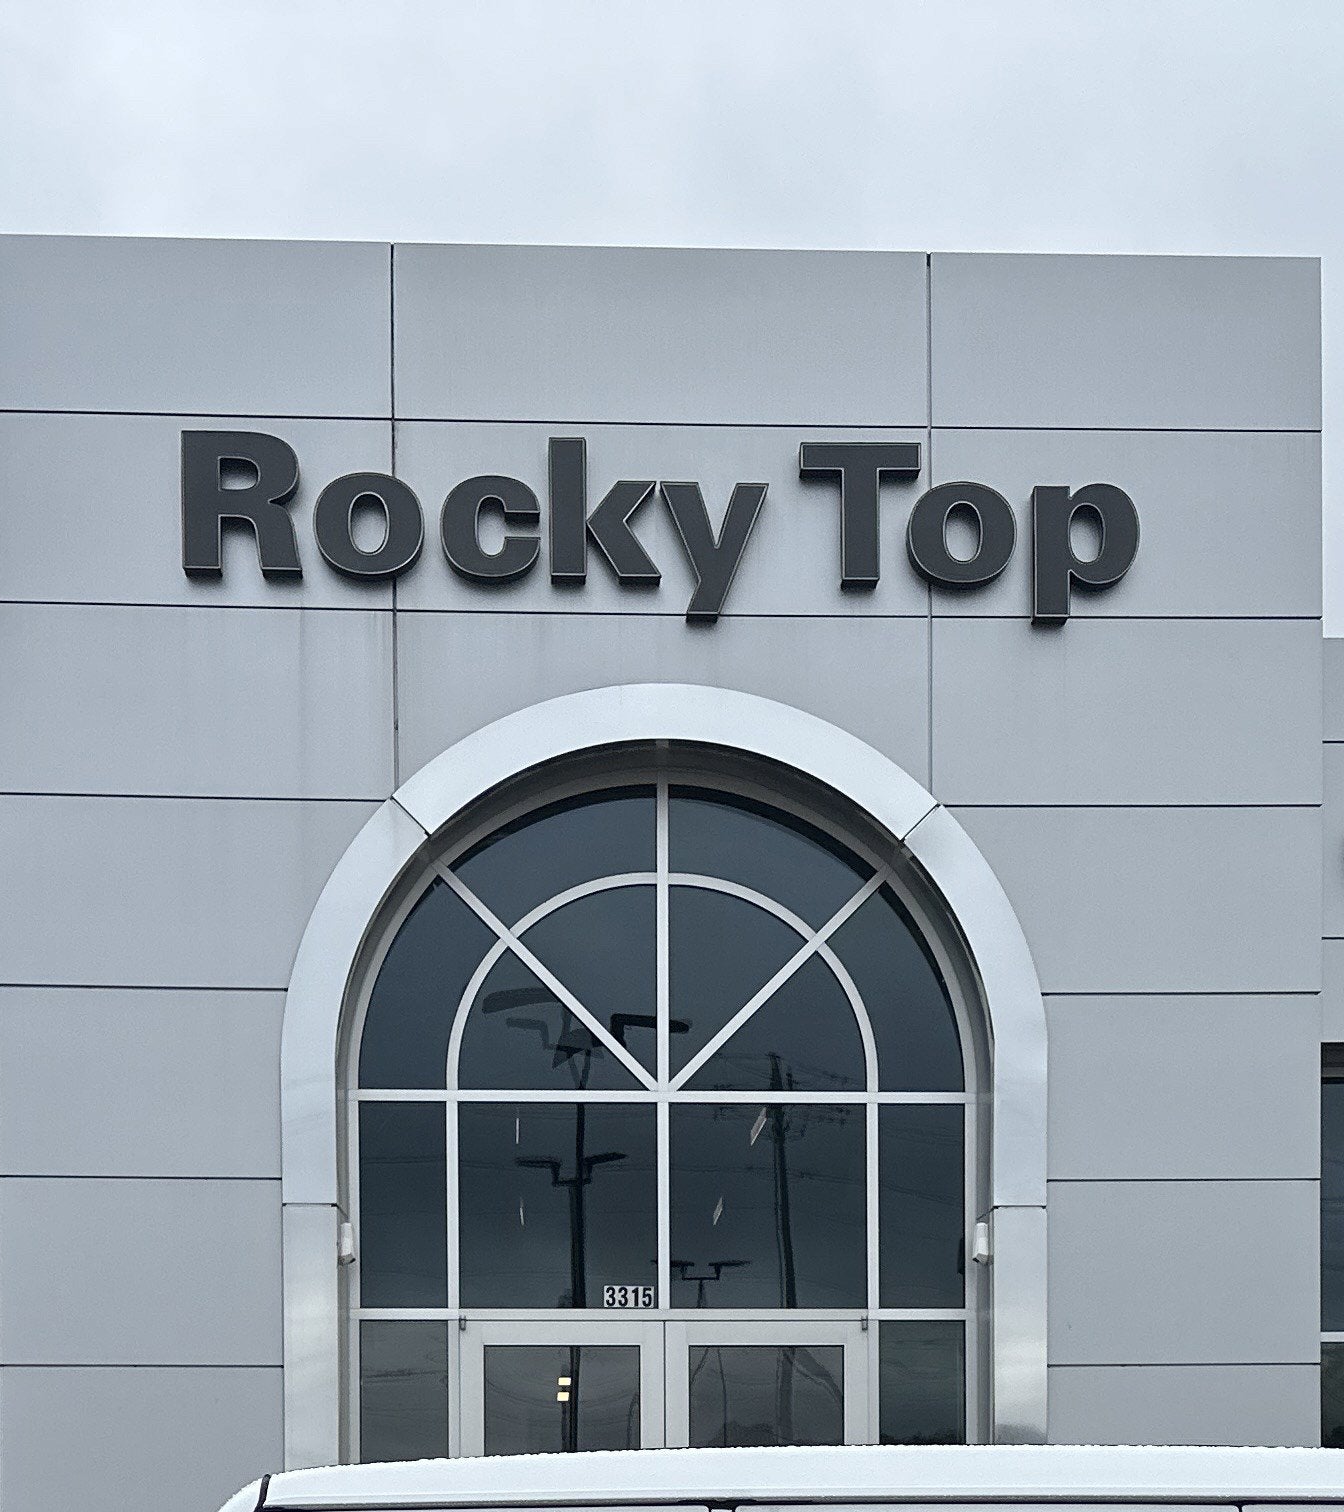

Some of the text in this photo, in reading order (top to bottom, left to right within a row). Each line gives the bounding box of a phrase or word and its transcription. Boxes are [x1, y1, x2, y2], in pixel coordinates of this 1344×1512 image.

[181, 429, 1140, 626] Rocky Top
[605, 1286, 652, 1307] 3315
